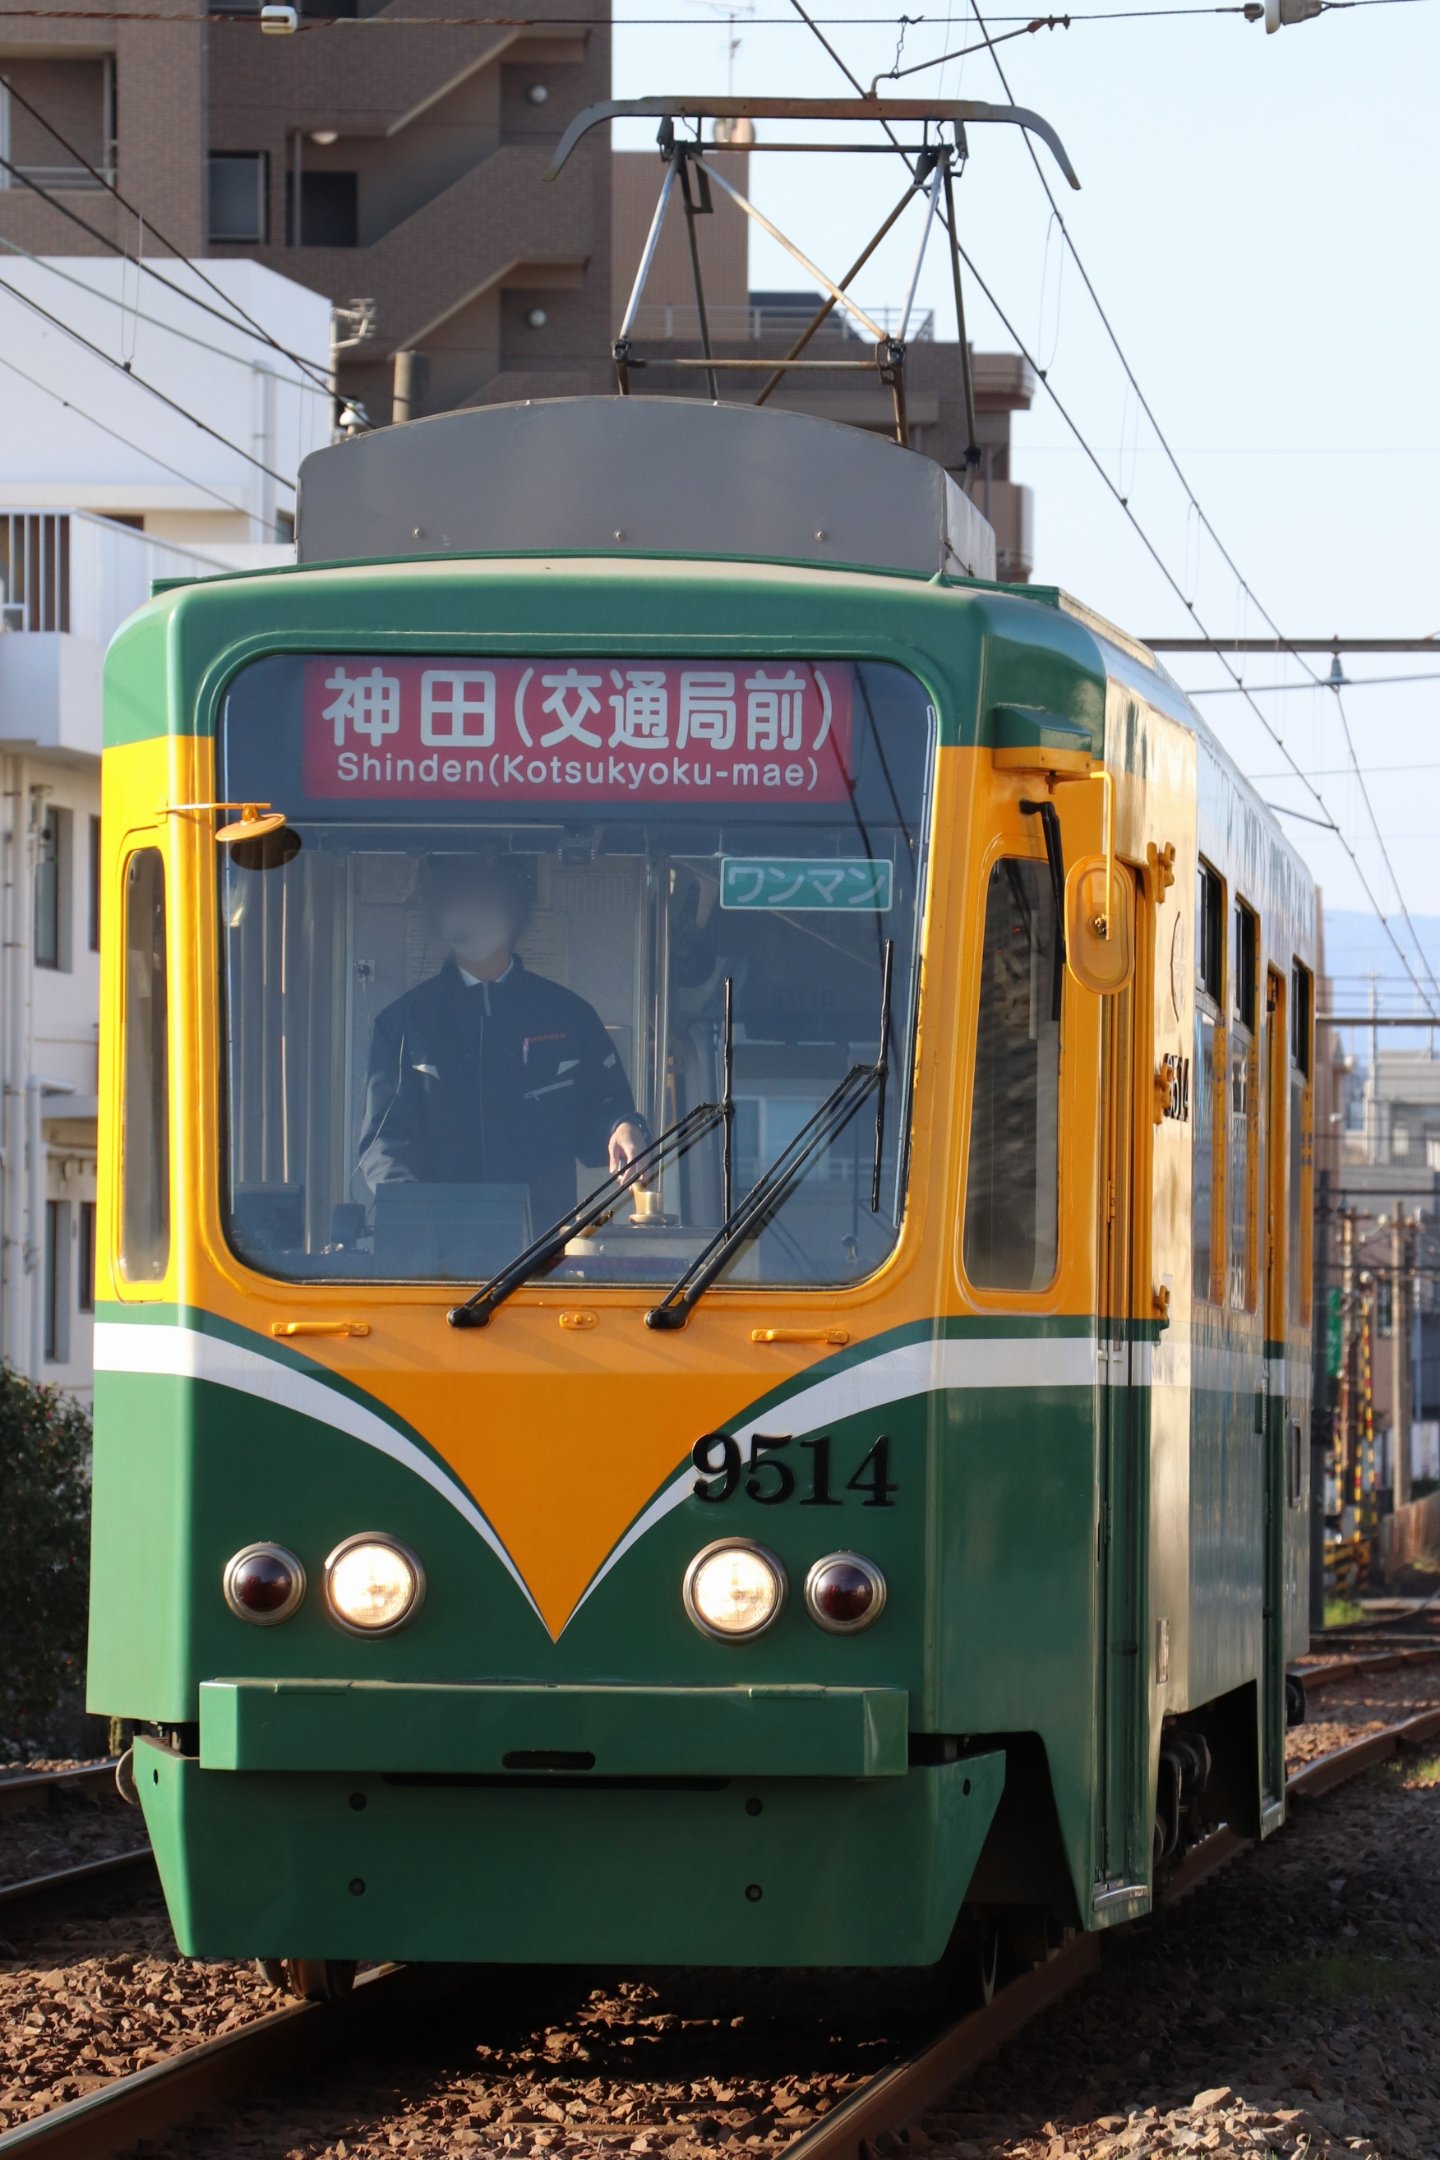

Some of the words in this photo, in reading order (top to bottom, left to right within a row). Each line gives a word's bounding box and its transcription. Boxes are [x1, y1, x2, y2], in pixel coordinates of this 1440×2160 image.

[322, 667, 832, 750] 神田(交通局前)
[338, 752, 818, 791] Shinden(Kotsukyoku-mae)
[728, 866, 886, 904] ワンマン
[692, 1433, 897, 1507] 9514
